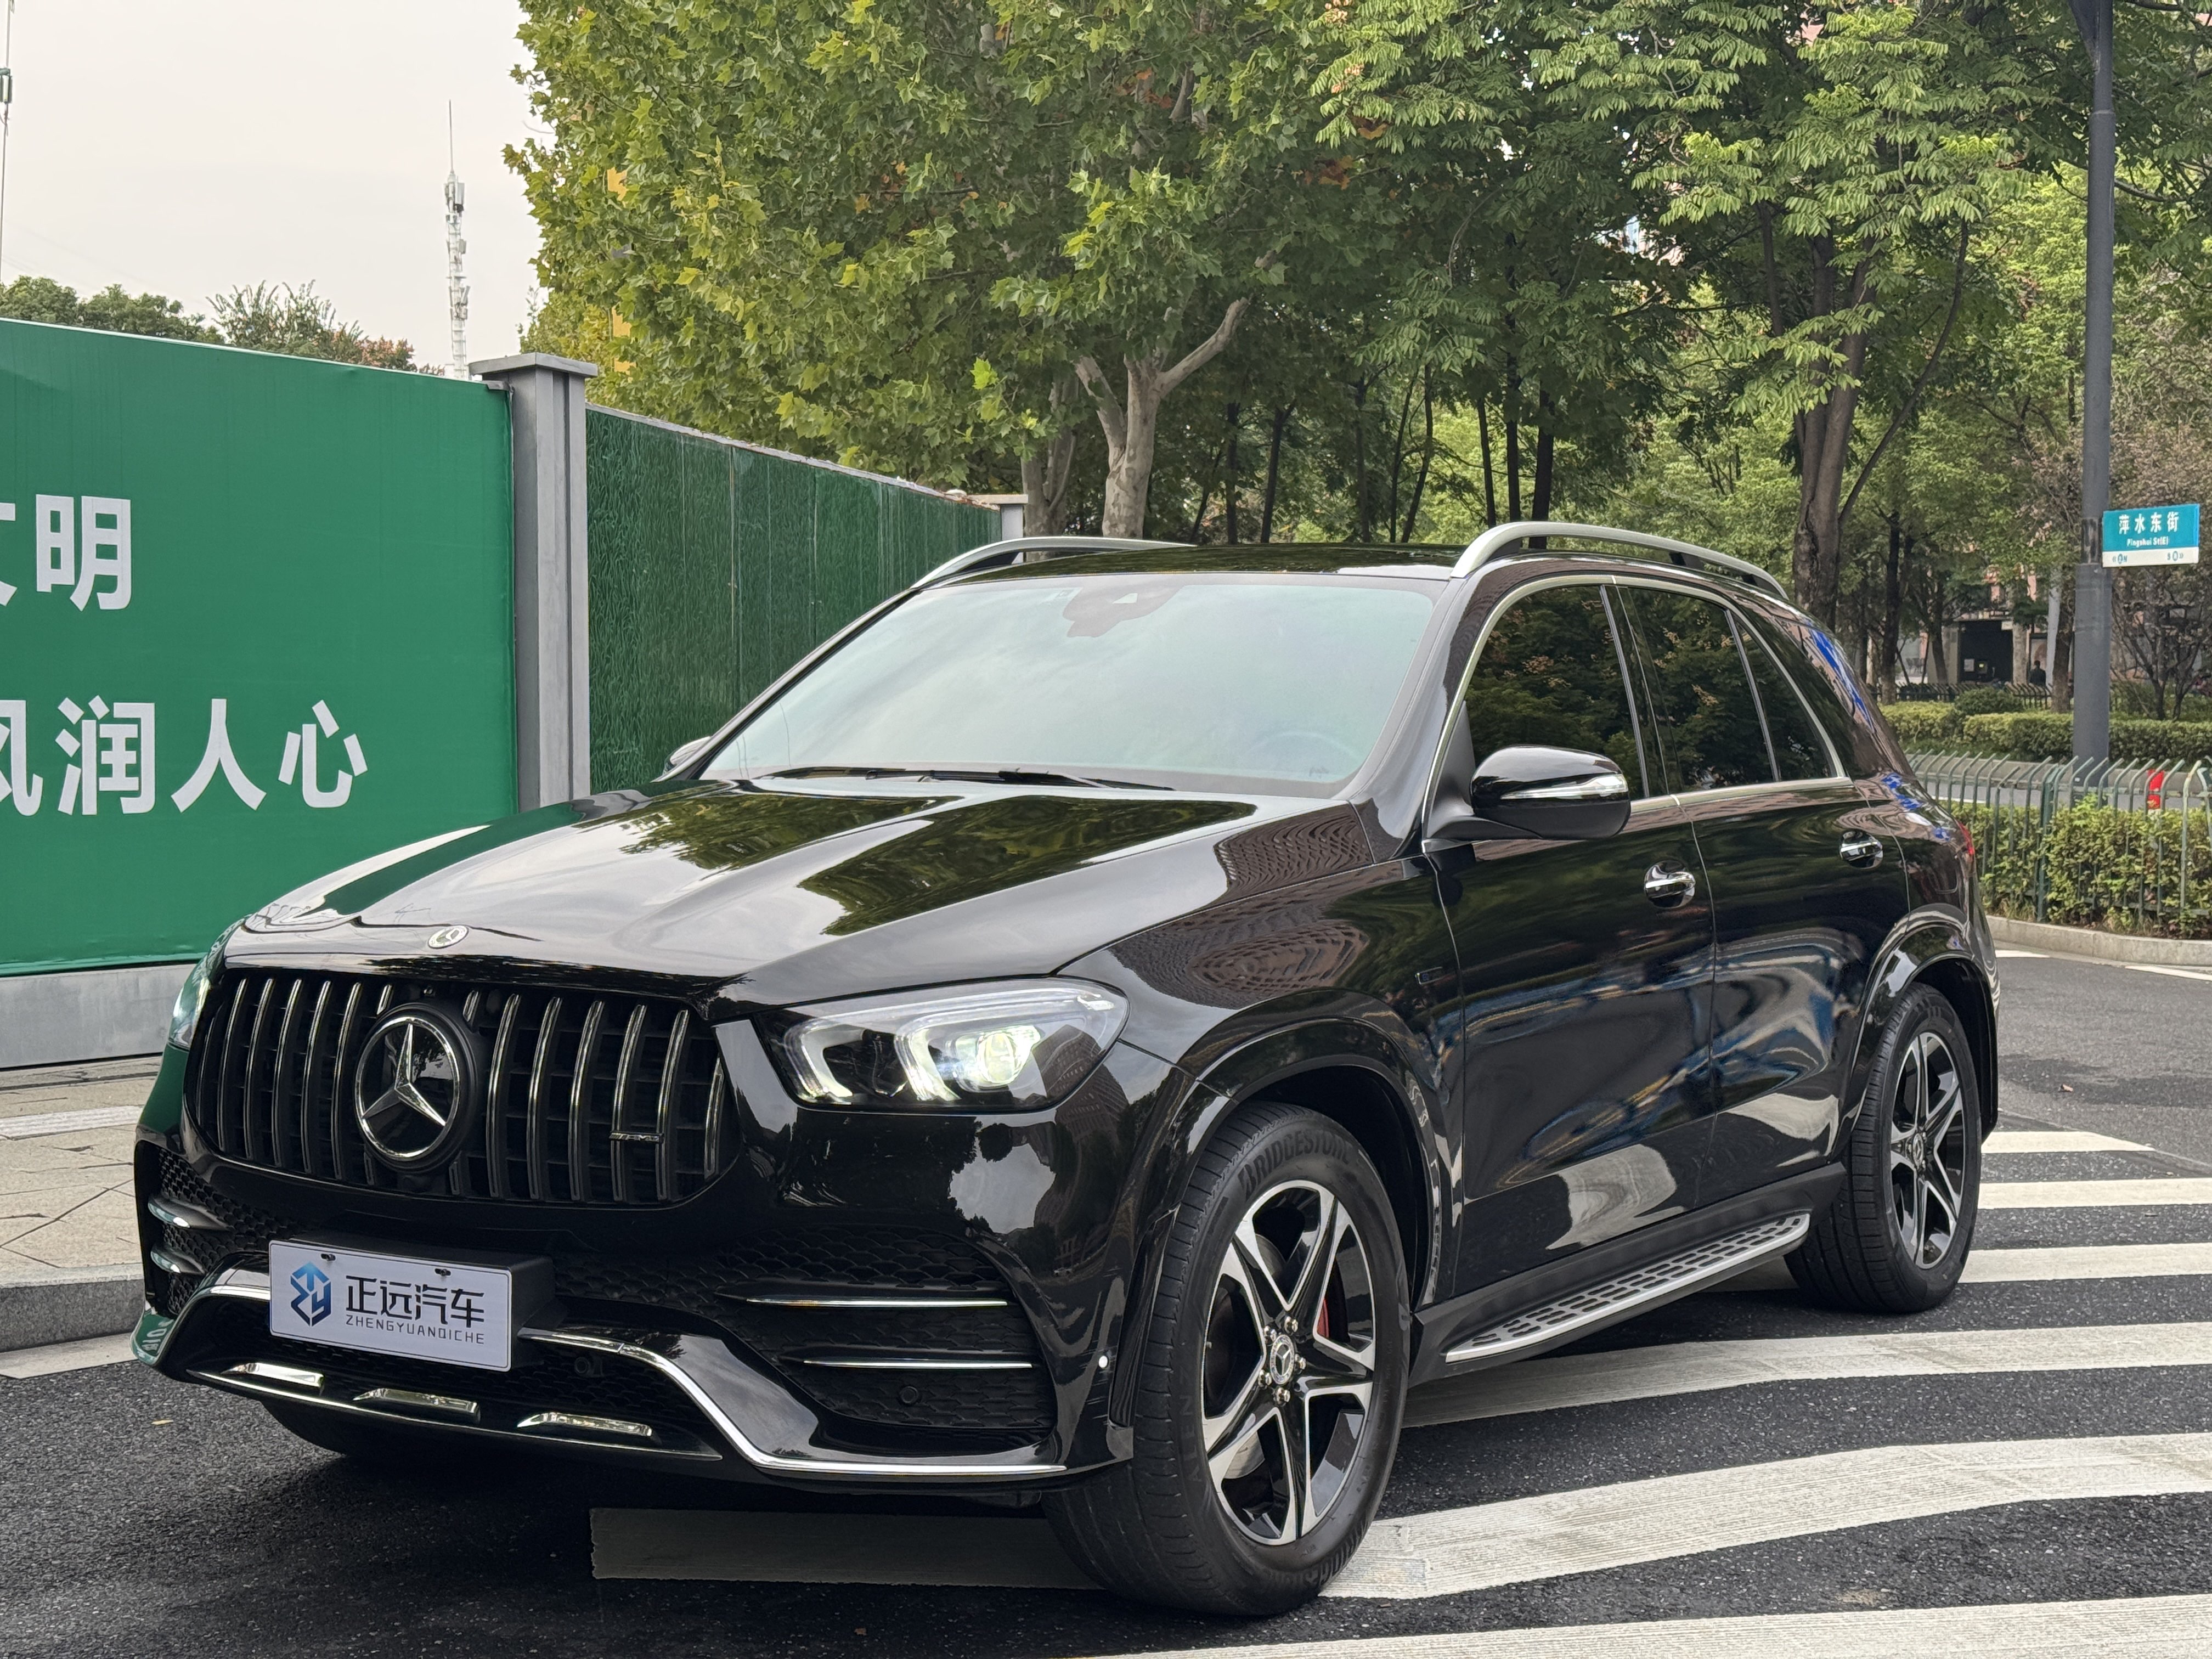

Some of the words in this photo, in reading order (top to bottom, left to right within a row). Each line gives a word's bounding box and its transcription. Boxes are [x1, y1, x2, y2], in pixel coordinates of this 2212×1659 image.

[2119, 511, 2180, 535] 萍水东街
[2127, 538, 2152, 548] Pingshui
[0, 494, 132, 612] 明
[1238, 1128, 1352, 1202] BRIDGESTONE
[346, 1274, 484, 1328] 正远汽车
[345, 1314, 484, 1345] ZHENGYUANQICHE
[1178, 1358, 1203, 1483] ALENZ
